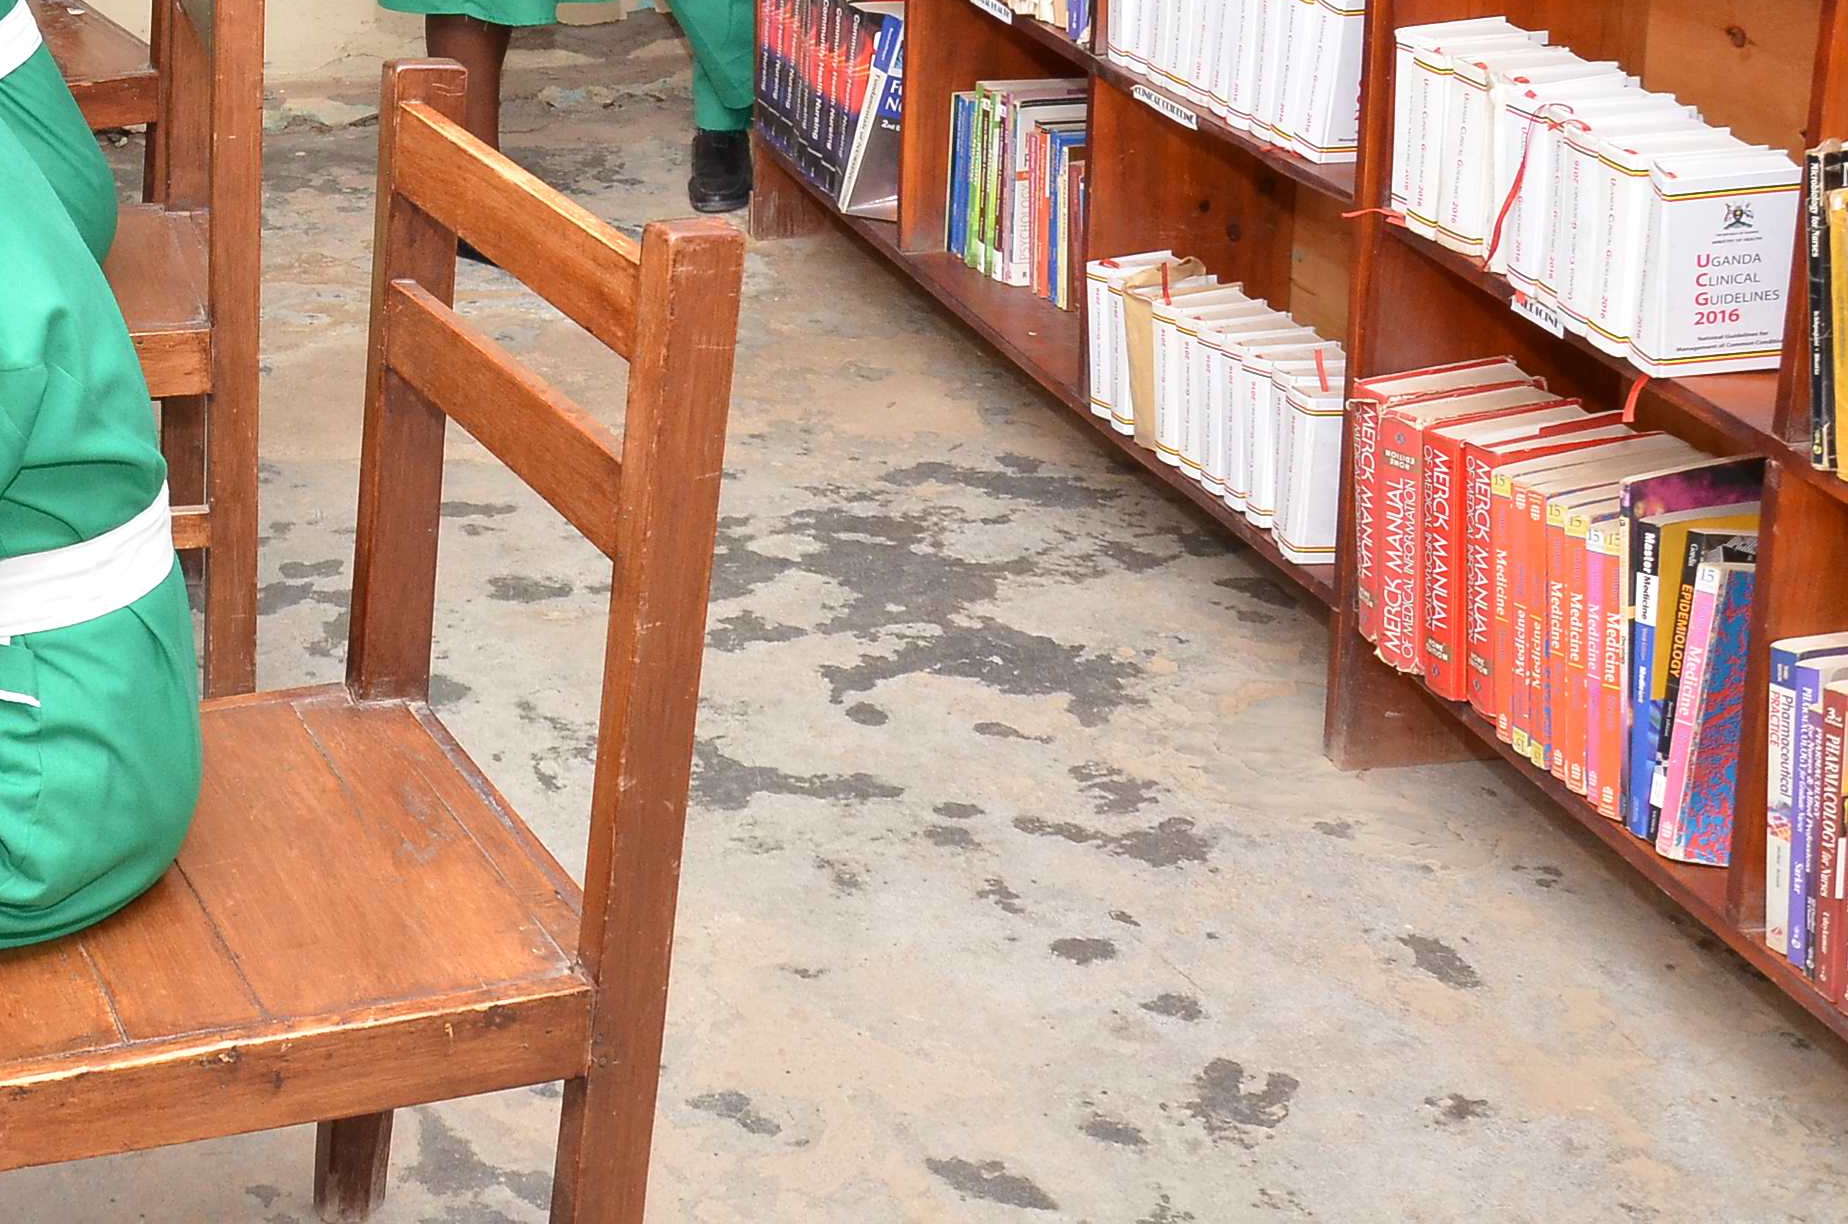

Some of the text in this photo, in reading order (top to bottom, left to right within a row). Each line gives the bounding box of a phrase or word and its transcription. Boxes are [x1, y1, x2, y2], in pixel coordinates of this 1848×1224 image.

[815, 59, 824, 97] Health
[811, 98, 821, 140] Nursing
[826, 109, 835, 150] Nursing
[1695, 272, 1760, 288] CLINICAL
[1697, 253, 1762, 268] UGANDA
[1694, 308, 1740, 325] 2016
[1695, 289, 1780, 306] GUIDELINES
[1360, 405, 1376, 578] MERCK MANUAL
[1493, 475, 1505, 486] 15
[1549, 504, 1561, 516] 15
[1431, 448, 1449, 632] MERCK MANUAL
[1473, 459, 1491, 644] MERCK MANUAL
[1568, 516, 1582, 528] 15
[1588, 530, 1600, 542] 15
[1384, 477, 1404, 654] MERCK MANUAL
[1402, 479, 1417, 658] OF MEDICAL INFORMATION
[1494, 548, 1507, 617] Medicine
[1640, 531, 1658, 622] Master Medicine
[1700, 569, 1714, 582] 15
[1550, 581, 1564, 651] Medicine
[1568, 591, 1582, 667] Medicine
[1588, 603, 1600, 677] Medicine
[1604, 611, 1621, 684] Medicine
[1669, 583, 1693, 679] EPIDEMIOLOGY
[1679, 645, 1703, 717] Medicine
[1769, 690, 1781, 748] PRACTICE
[1781, 694, 1794, 800] Pharmaceutical
[1821, 735, 1840, 851] PHARMACOLOGY
[1793, 861, 1804, 894] Sarkar
[1819, 867, 1834, 898] Nurses
